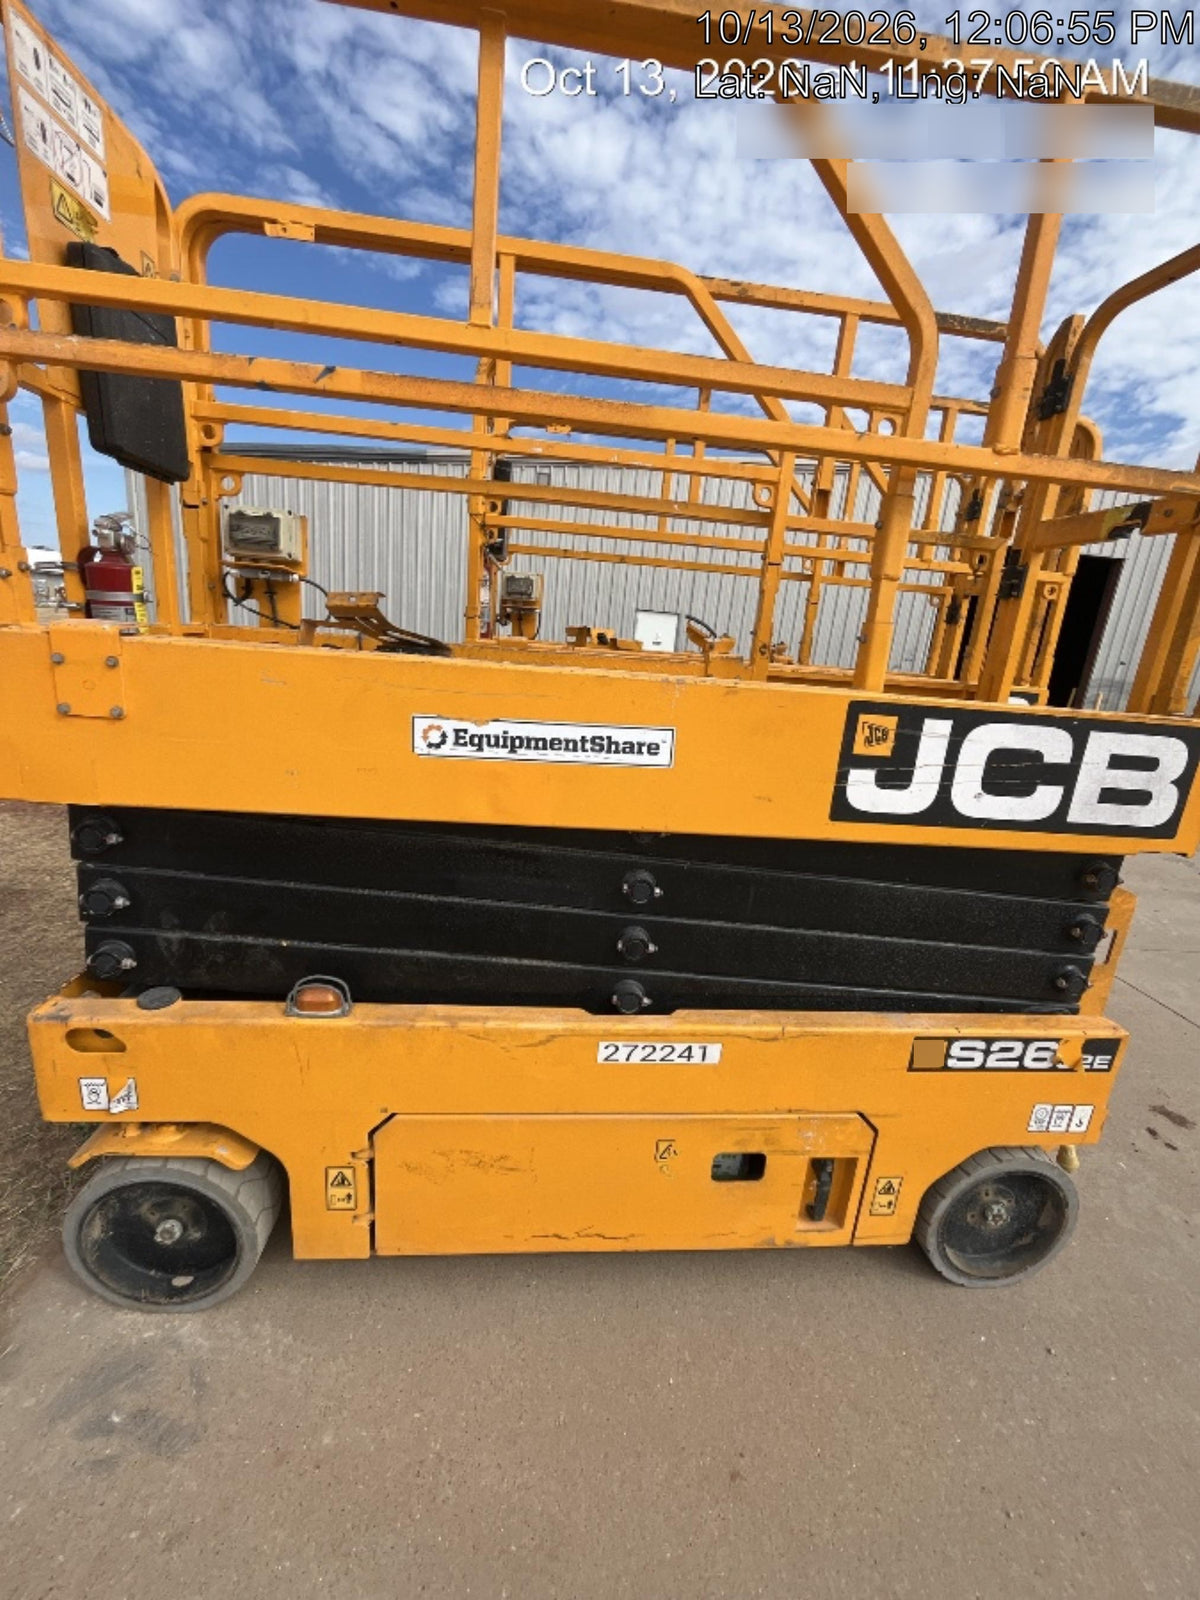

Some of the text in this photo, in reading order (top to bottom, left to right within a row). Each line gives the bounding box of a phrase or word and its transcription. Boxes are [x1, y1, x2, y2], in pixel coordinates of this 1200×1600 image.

[452, 728, 661, 757] EquipmentShare
[863, 722, 889, 748] JCB
[845, 717, 1189, 828] JCB
[602, 1043, 708, 1063] 272241
